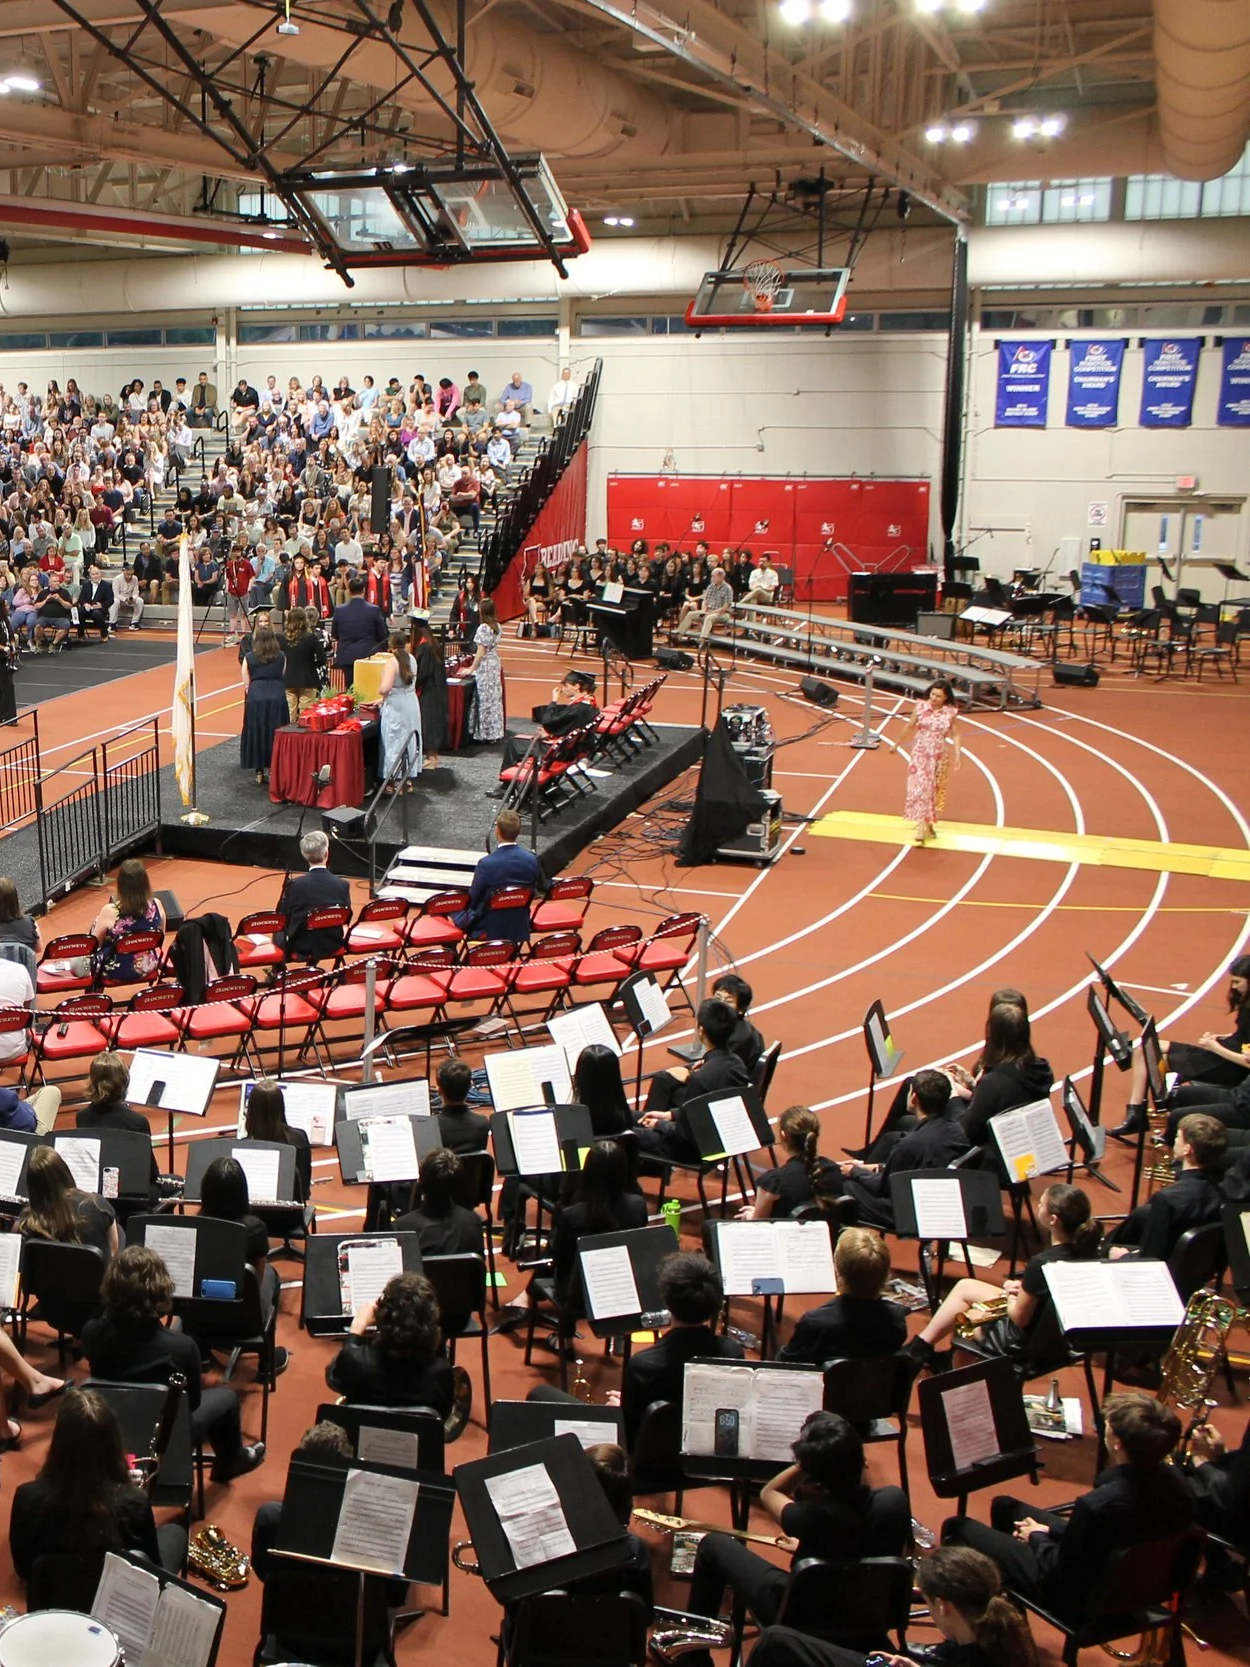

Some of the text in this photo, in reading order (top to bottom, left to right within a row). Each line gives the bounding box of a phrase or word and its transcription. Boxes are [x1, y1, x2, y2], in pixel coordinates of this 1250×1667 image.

[125, 937, 153, 946] ROCKETS
[58, 943, 87, 951] ROCKETS
[215, 985, 246, 994] ROCKETS
[144, 994, 175, 1003] ROCKETS
